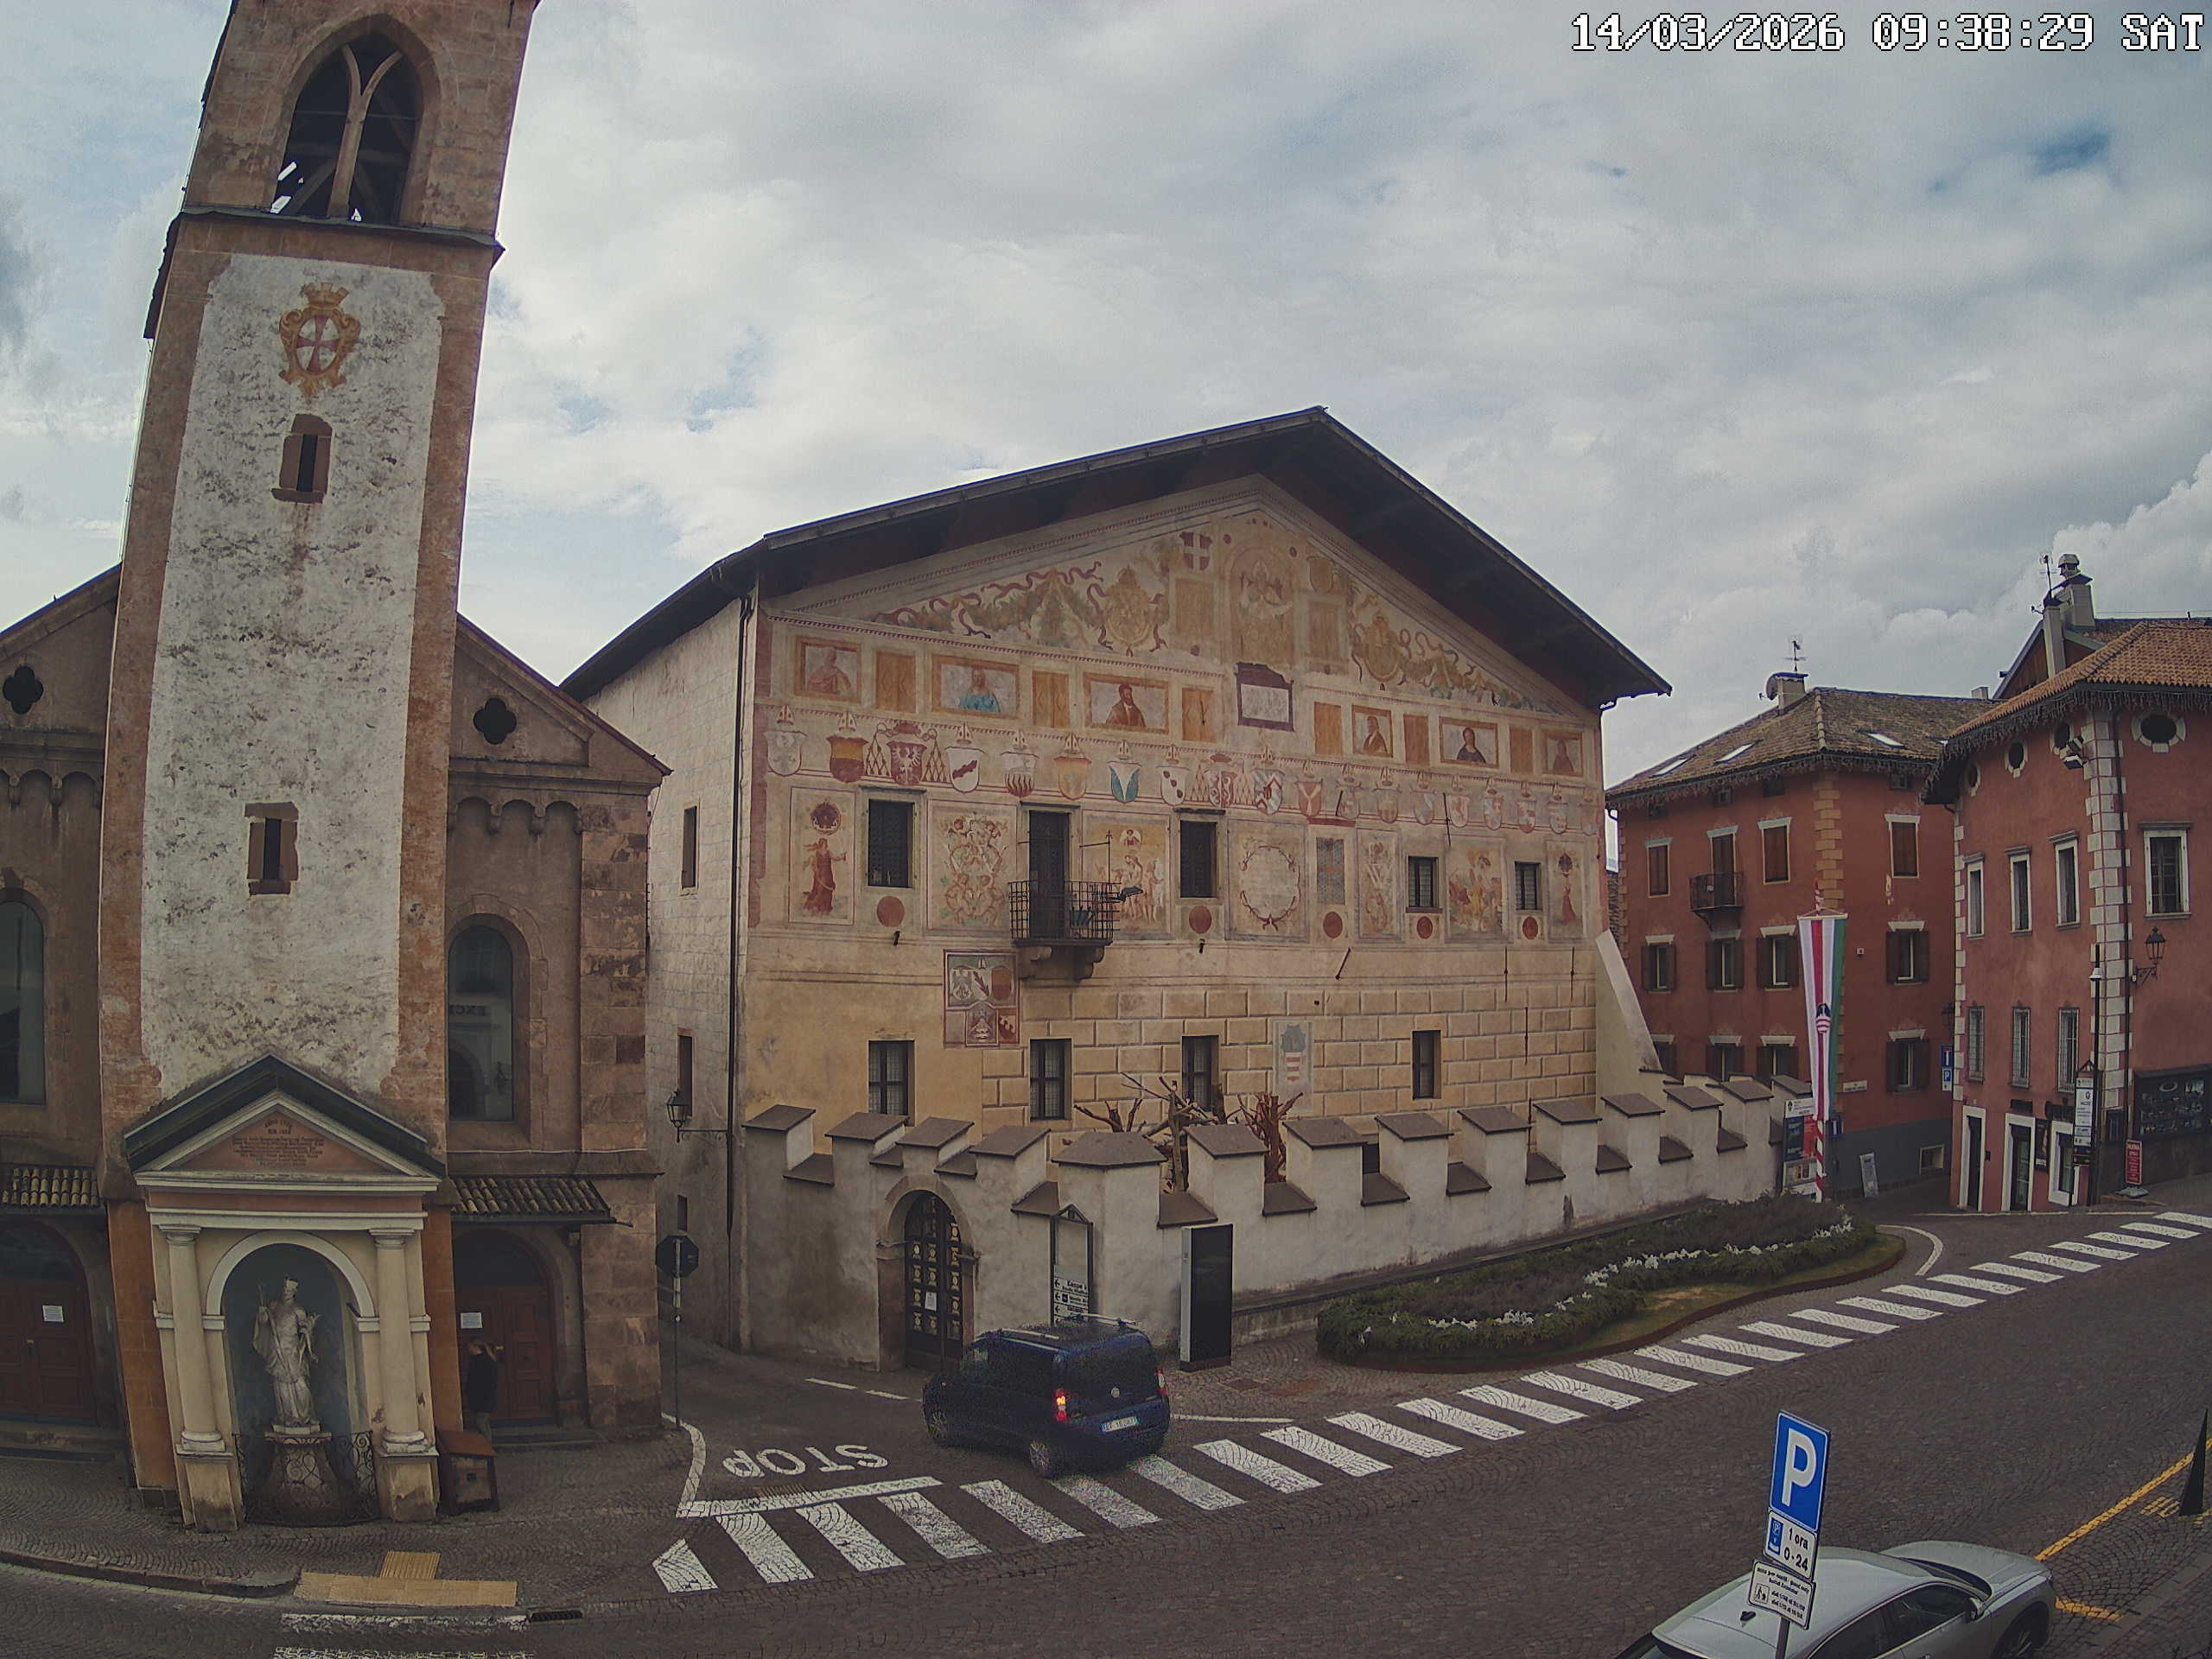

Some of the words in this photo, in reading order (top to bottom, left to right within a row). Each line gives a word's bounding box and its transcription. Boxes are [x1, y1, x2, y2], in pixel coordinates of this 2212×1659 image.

[722, 1444, 888, 1478] STOP
[1782, 1427, 1816, 1506] P
[1789, 1528, 1793, 1541] 1
[1795, 1535, 1808, 1549] ora
